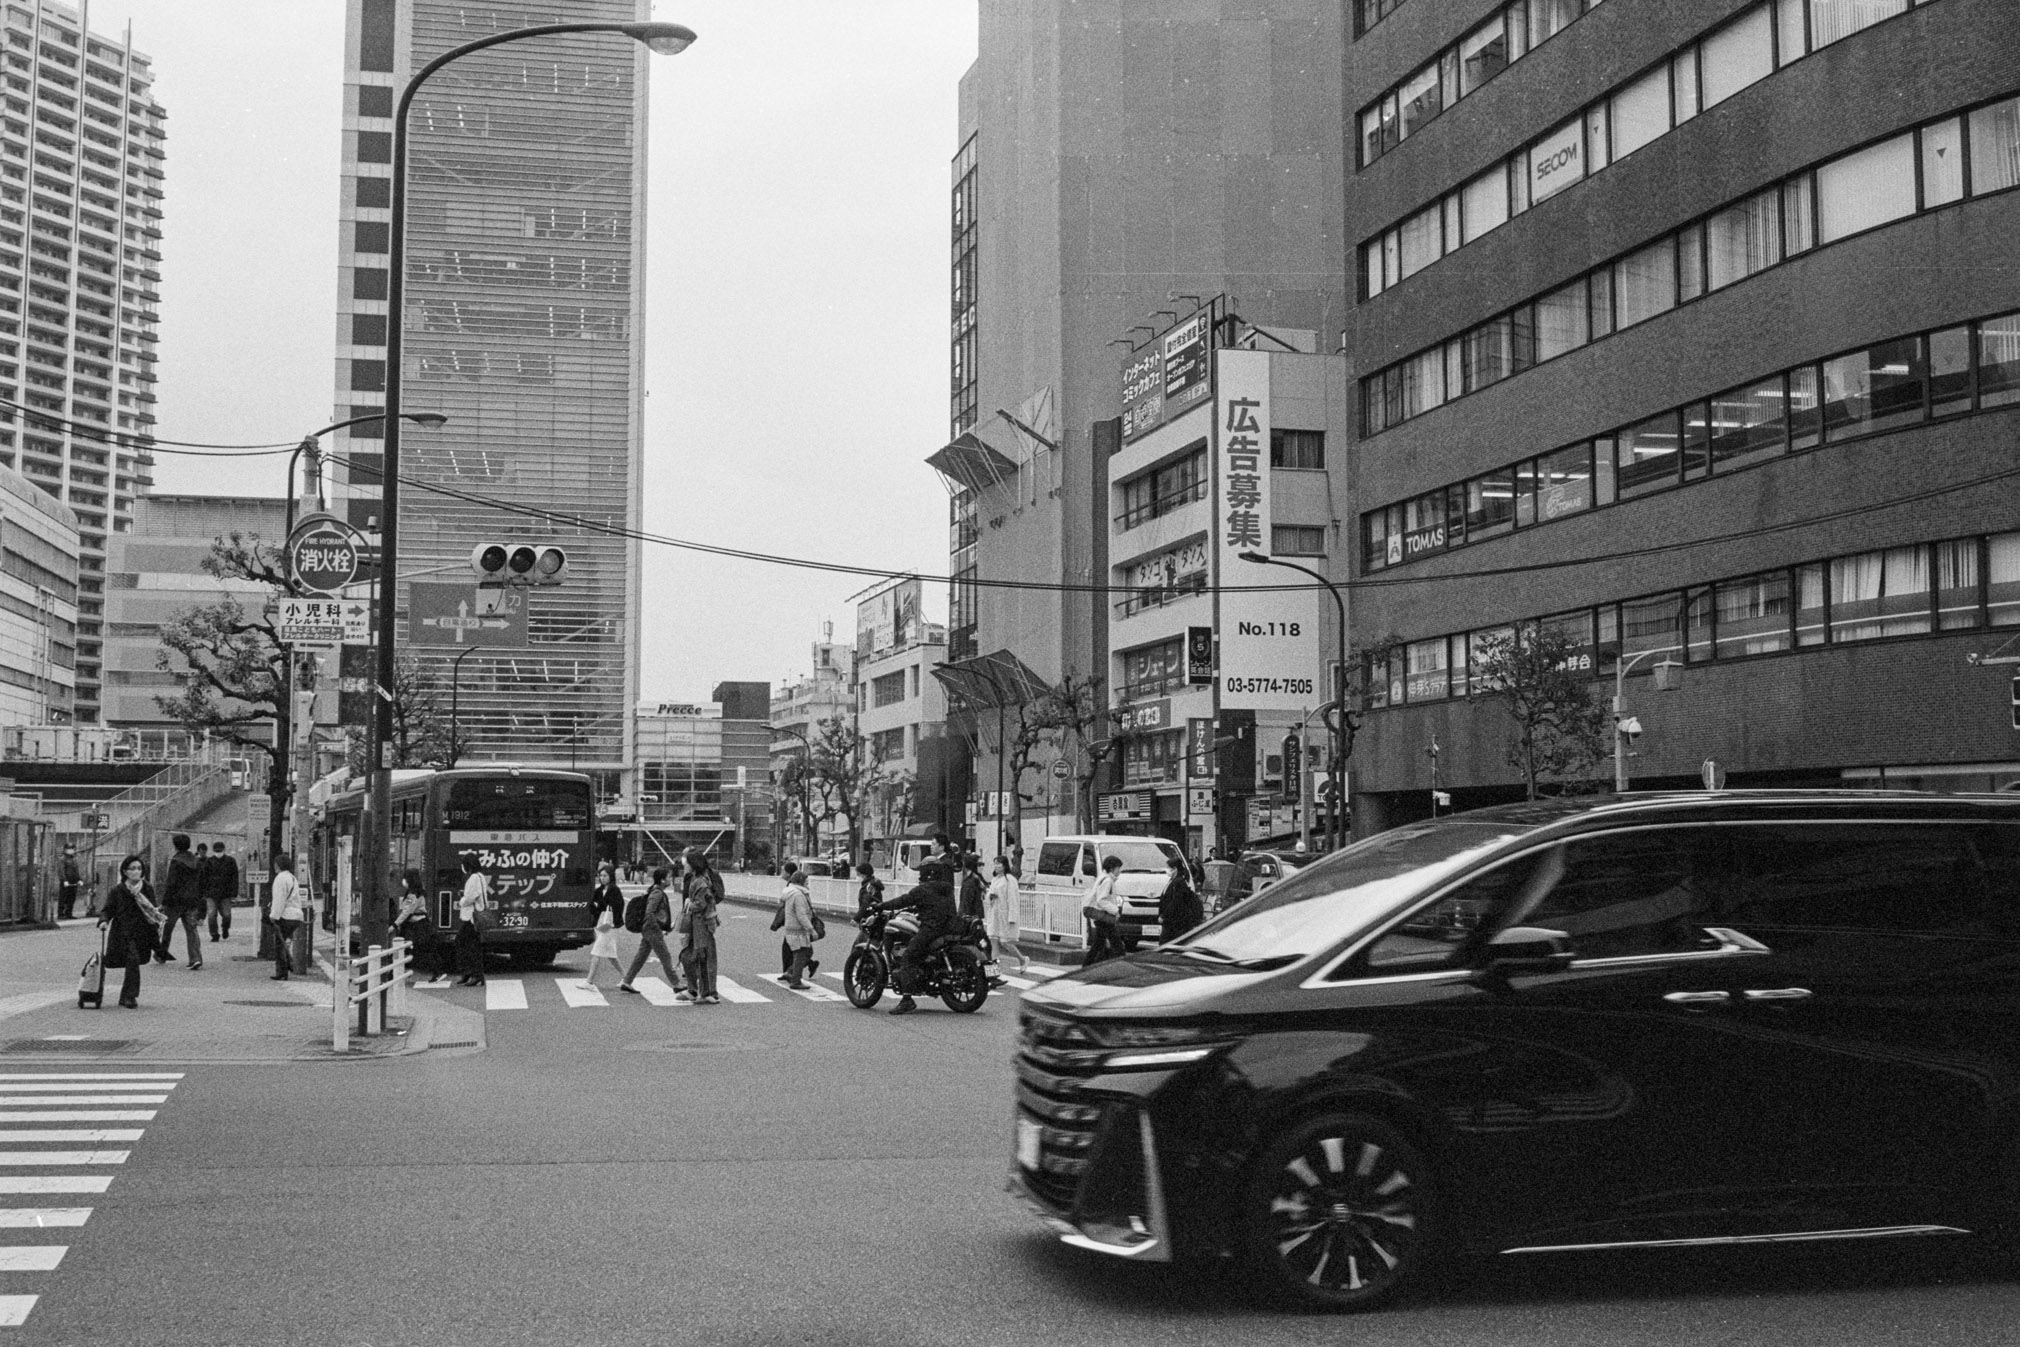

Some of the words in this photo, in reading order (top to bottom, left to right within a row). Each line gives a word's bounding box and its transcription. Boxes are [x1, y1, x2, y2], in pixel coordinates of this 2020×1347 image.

[1536, 142, 1577, 181] SECOM
[1123, 350, 1161, 385] インターネット
[1123, 372, 1161, 404] コミックカフェ
[1225, 397, 1262, 548] 広告募集
[1406, 528, 1444, 554] TOMAS
[300, 548, 351, 572] 消火栓
[285, 603, 341, 618] 小児科
[1238, 621, 1301, 637] No.118
[1139, 651, 1179, 679] シェーン
[1227, 677, 1313, 694] 03-5774-7505
[657, 704, 702, 715] Precce
[1196, 720, 1208, 775] ほけんの窓口
[458, 849, 569, 869] みふの仲介
